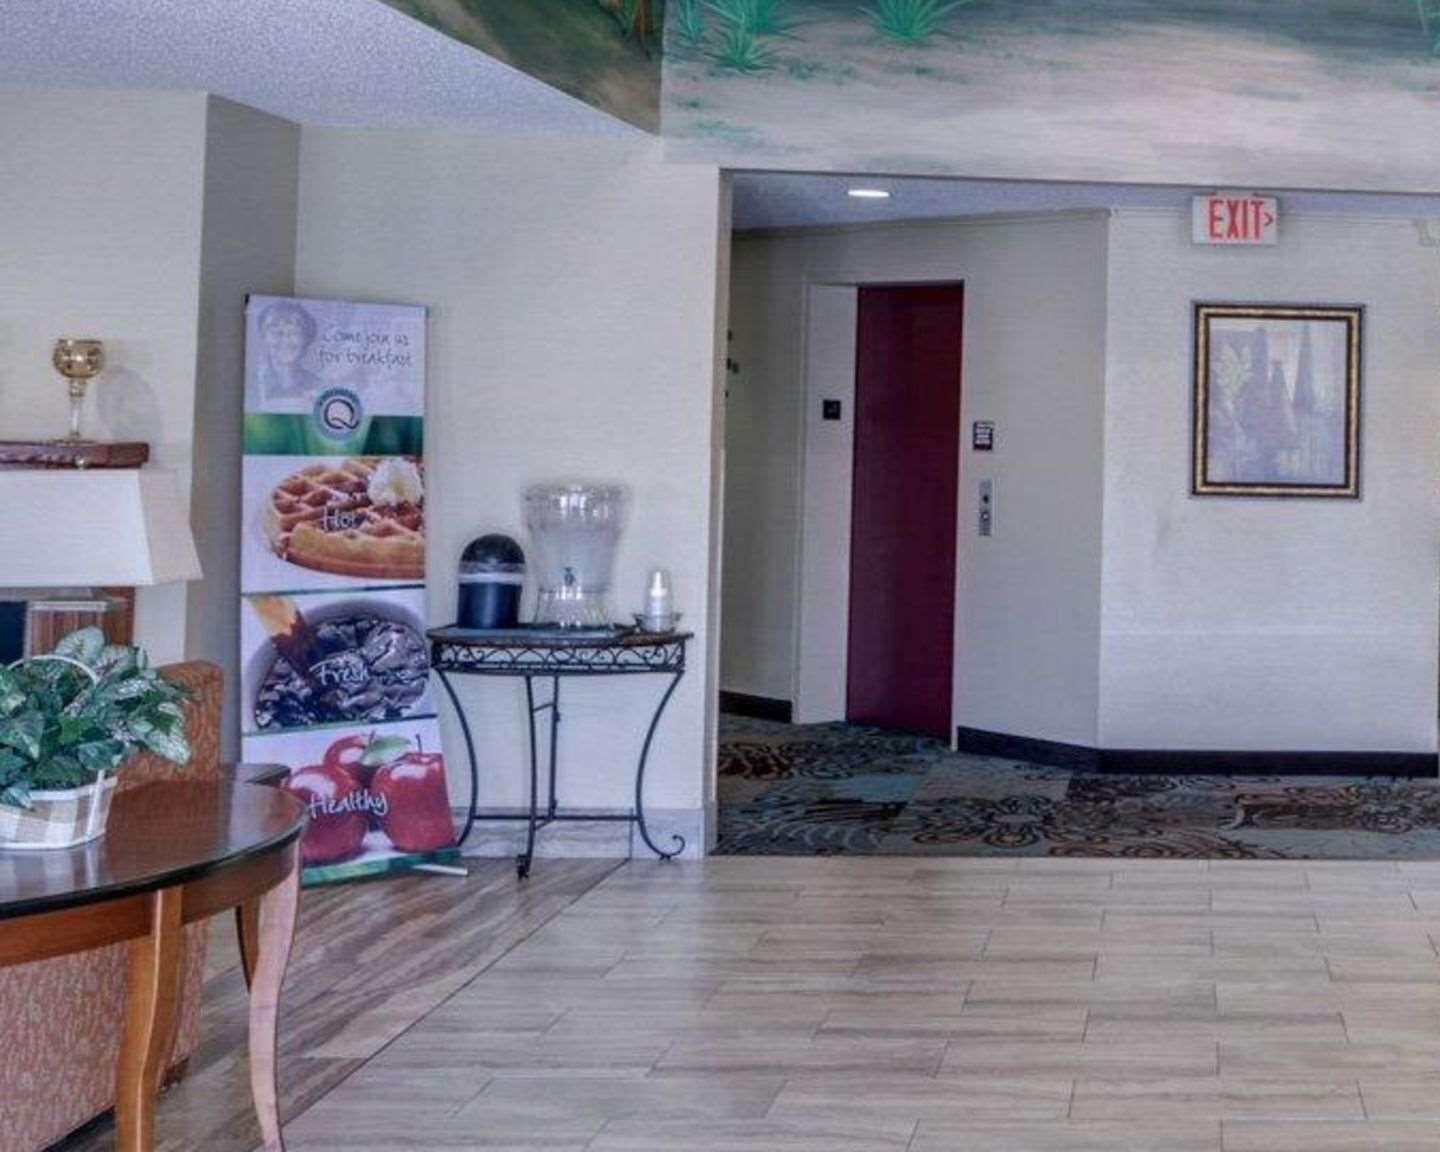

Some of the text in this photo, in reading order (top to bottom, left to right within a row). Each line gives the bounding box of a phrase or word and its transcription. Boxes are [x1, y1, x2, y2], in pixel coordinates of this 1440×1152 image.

[1208, 199, 1264, 239] EXIT
[319, 348, 412, 371] for breakfast
[309, 789, 389, 818] Healthy
